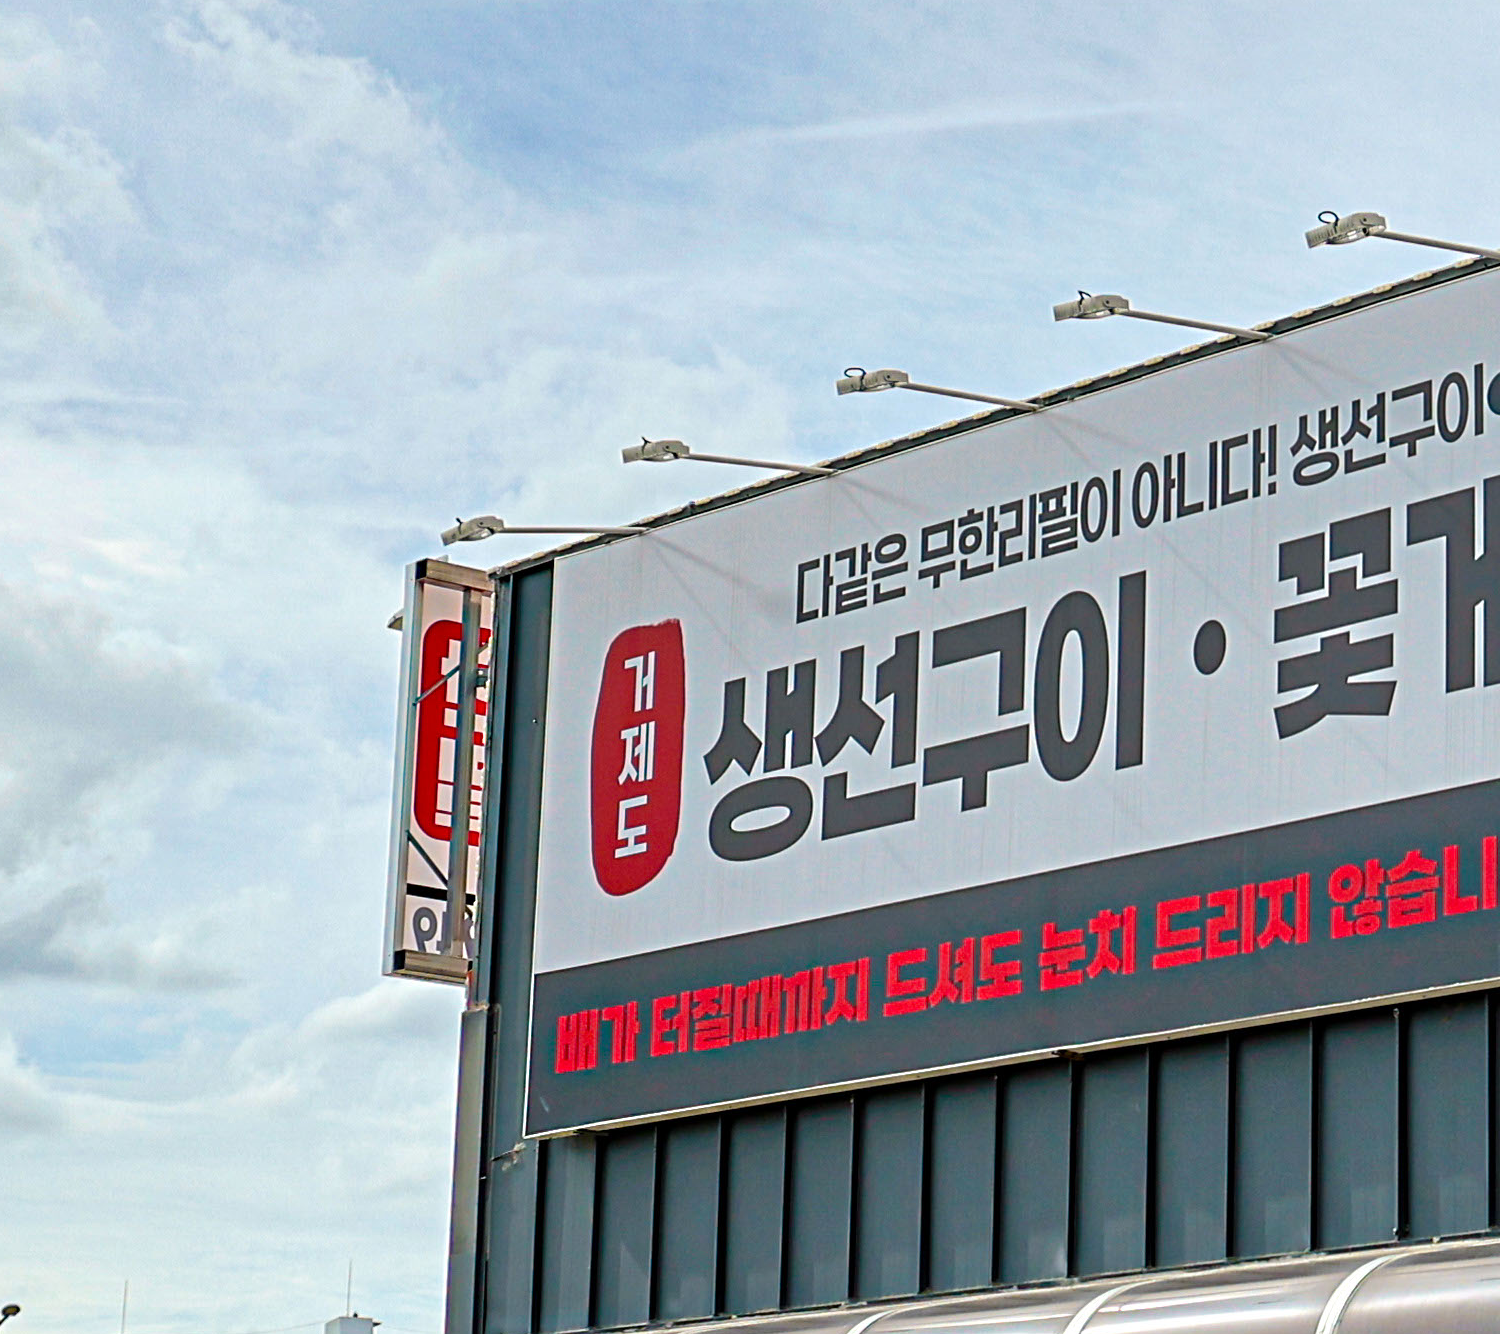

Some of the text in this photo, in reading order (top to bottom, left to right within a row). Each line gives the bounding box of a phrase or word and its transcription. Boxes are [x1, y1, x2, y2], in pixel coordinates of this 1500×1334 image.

[796, 533, 908, 624] 다같은
[919, 469, 1121, 589] 무한리필이
[1132, 424, 1277, 529] 아니다!
[614, 650, 657, 860] 거제도
[703, 570, 1148, 862] 생선구이
[554, 999, 639, 1074] 배가
[651, 957, 870, 1057] 터질때까지
[883, 929, 1024, 1017] 드셔도
[1038, 904, 1136, 991] 눈치
[1152, 873, 1311, 970] 드리지
